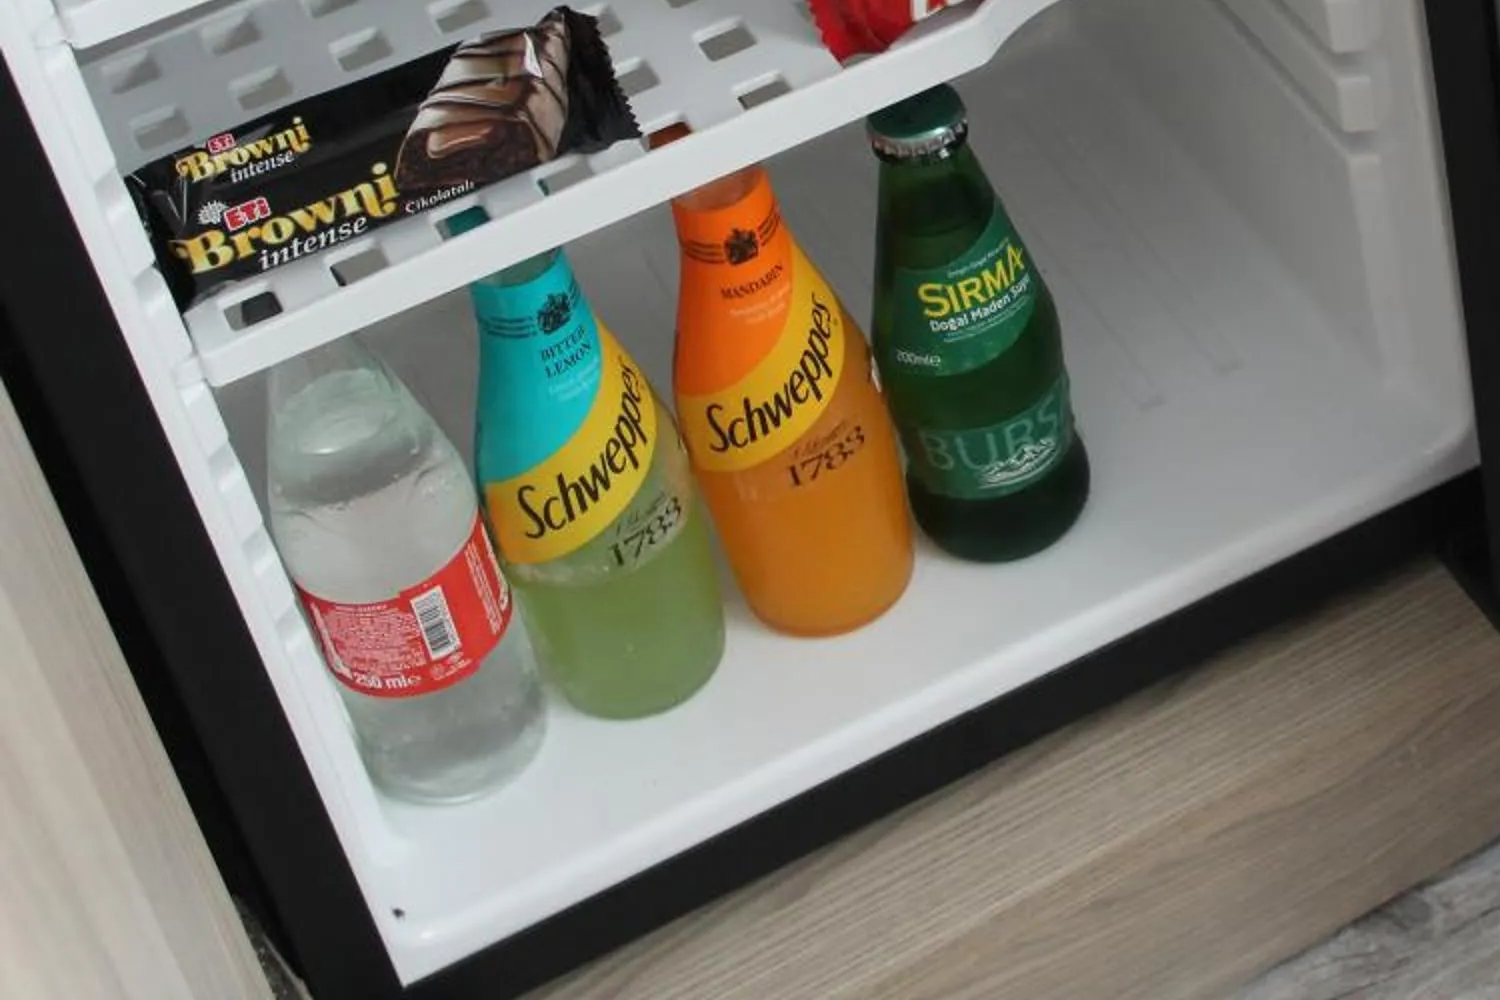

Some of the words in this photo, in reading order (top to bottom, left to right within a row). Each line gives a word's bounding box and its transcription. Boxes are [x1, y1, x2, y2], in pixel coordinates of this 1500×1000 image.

[177, 117, 312, 185] Browni
[230, 151, 295, 186] intense
[170, 162, 400, 275] Browni
[258, 216, 368, 272] intense
[970, 293, 1011, 323] Maden
[539, 326, 586, 363] BITTER
[544, 342, 592, 378] LEMON
[707, 294, 833, 453] Schweppes
[517, 354, 647, 541] Schweppes
[785, 427, 866, 487] 1783
[607, 496, 683, 567] 1783
